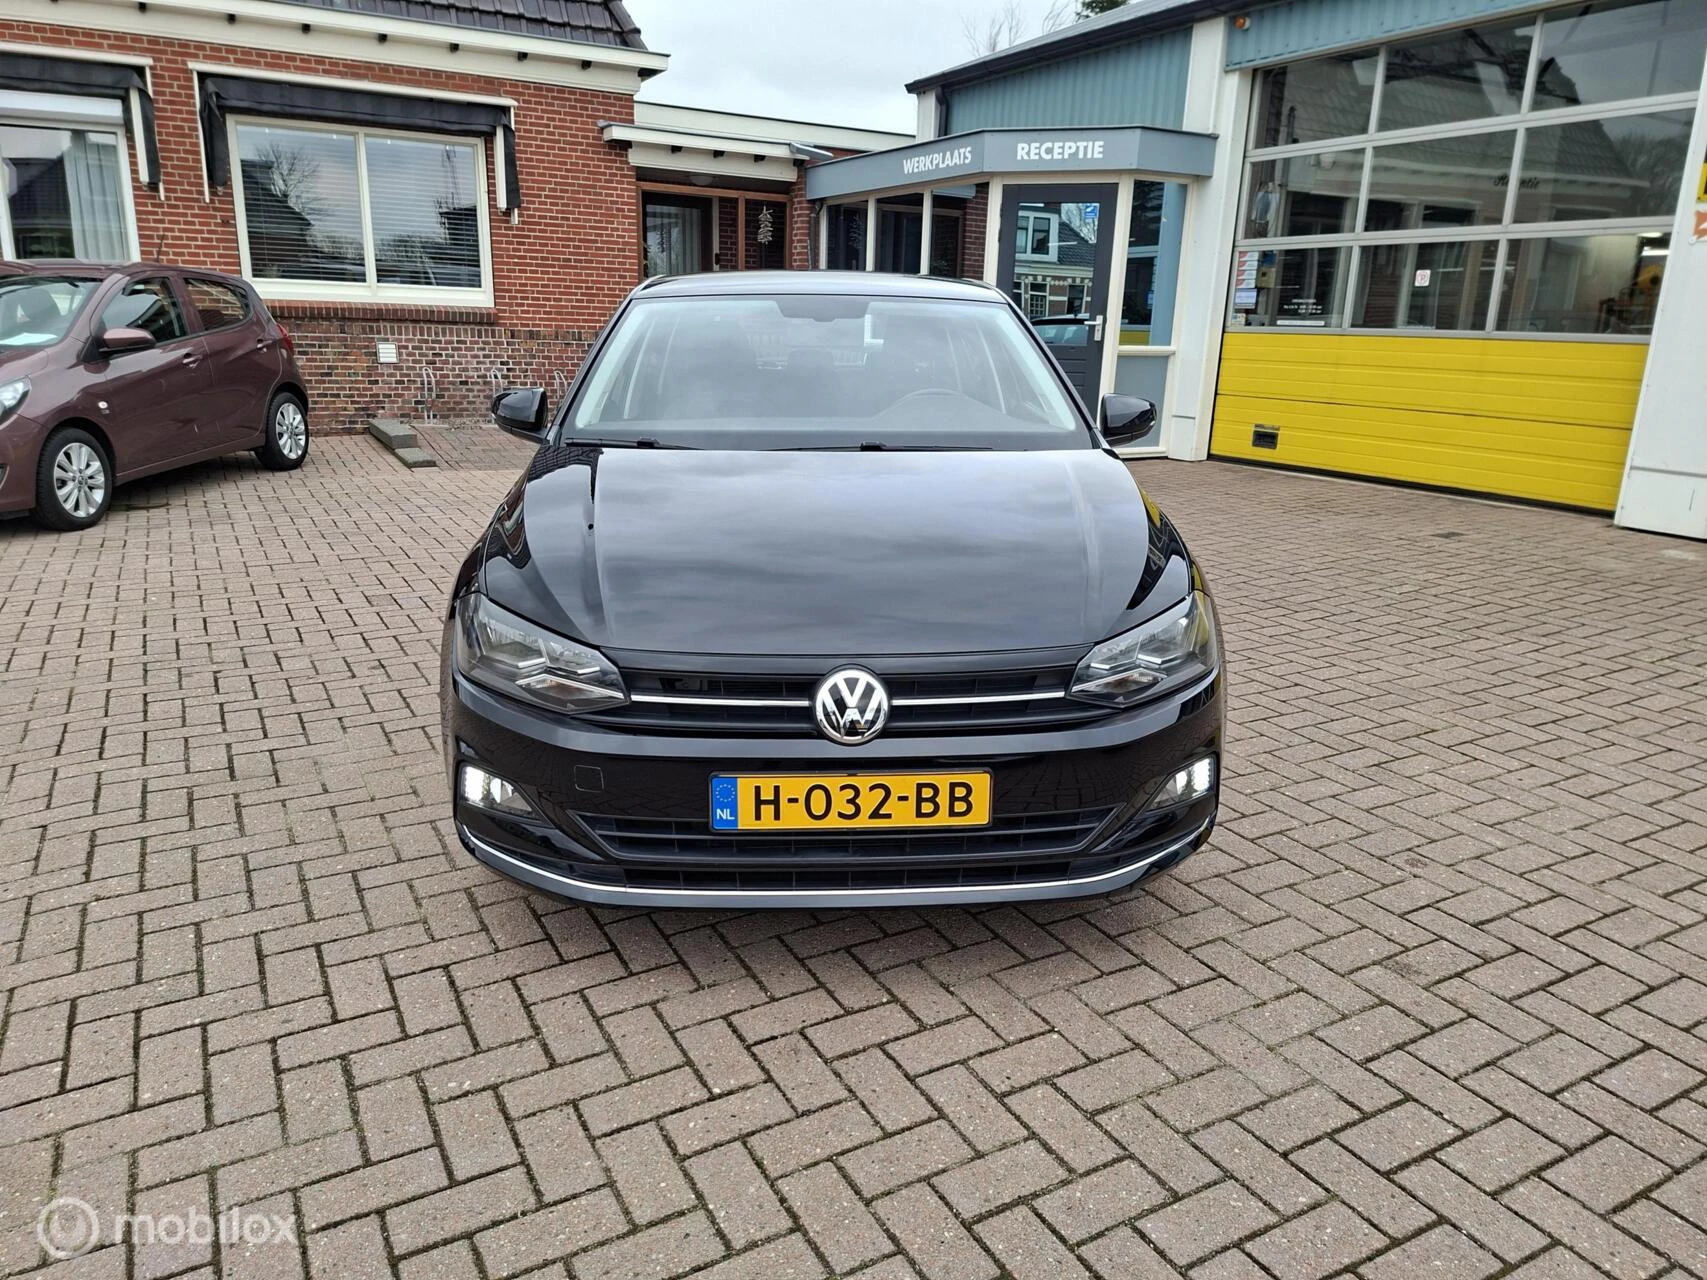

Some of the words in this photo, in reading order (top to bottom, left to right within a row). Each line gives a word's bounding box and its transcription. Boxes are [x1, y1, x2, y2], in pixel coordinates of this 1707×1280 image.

[903, 146, 972, 174] WERKPLAATS
[1016, 141, 1104, 161] RECEPTIE
[753, 782, 974, 821] H-032-BB
[716, 808, 735, 820] NL
